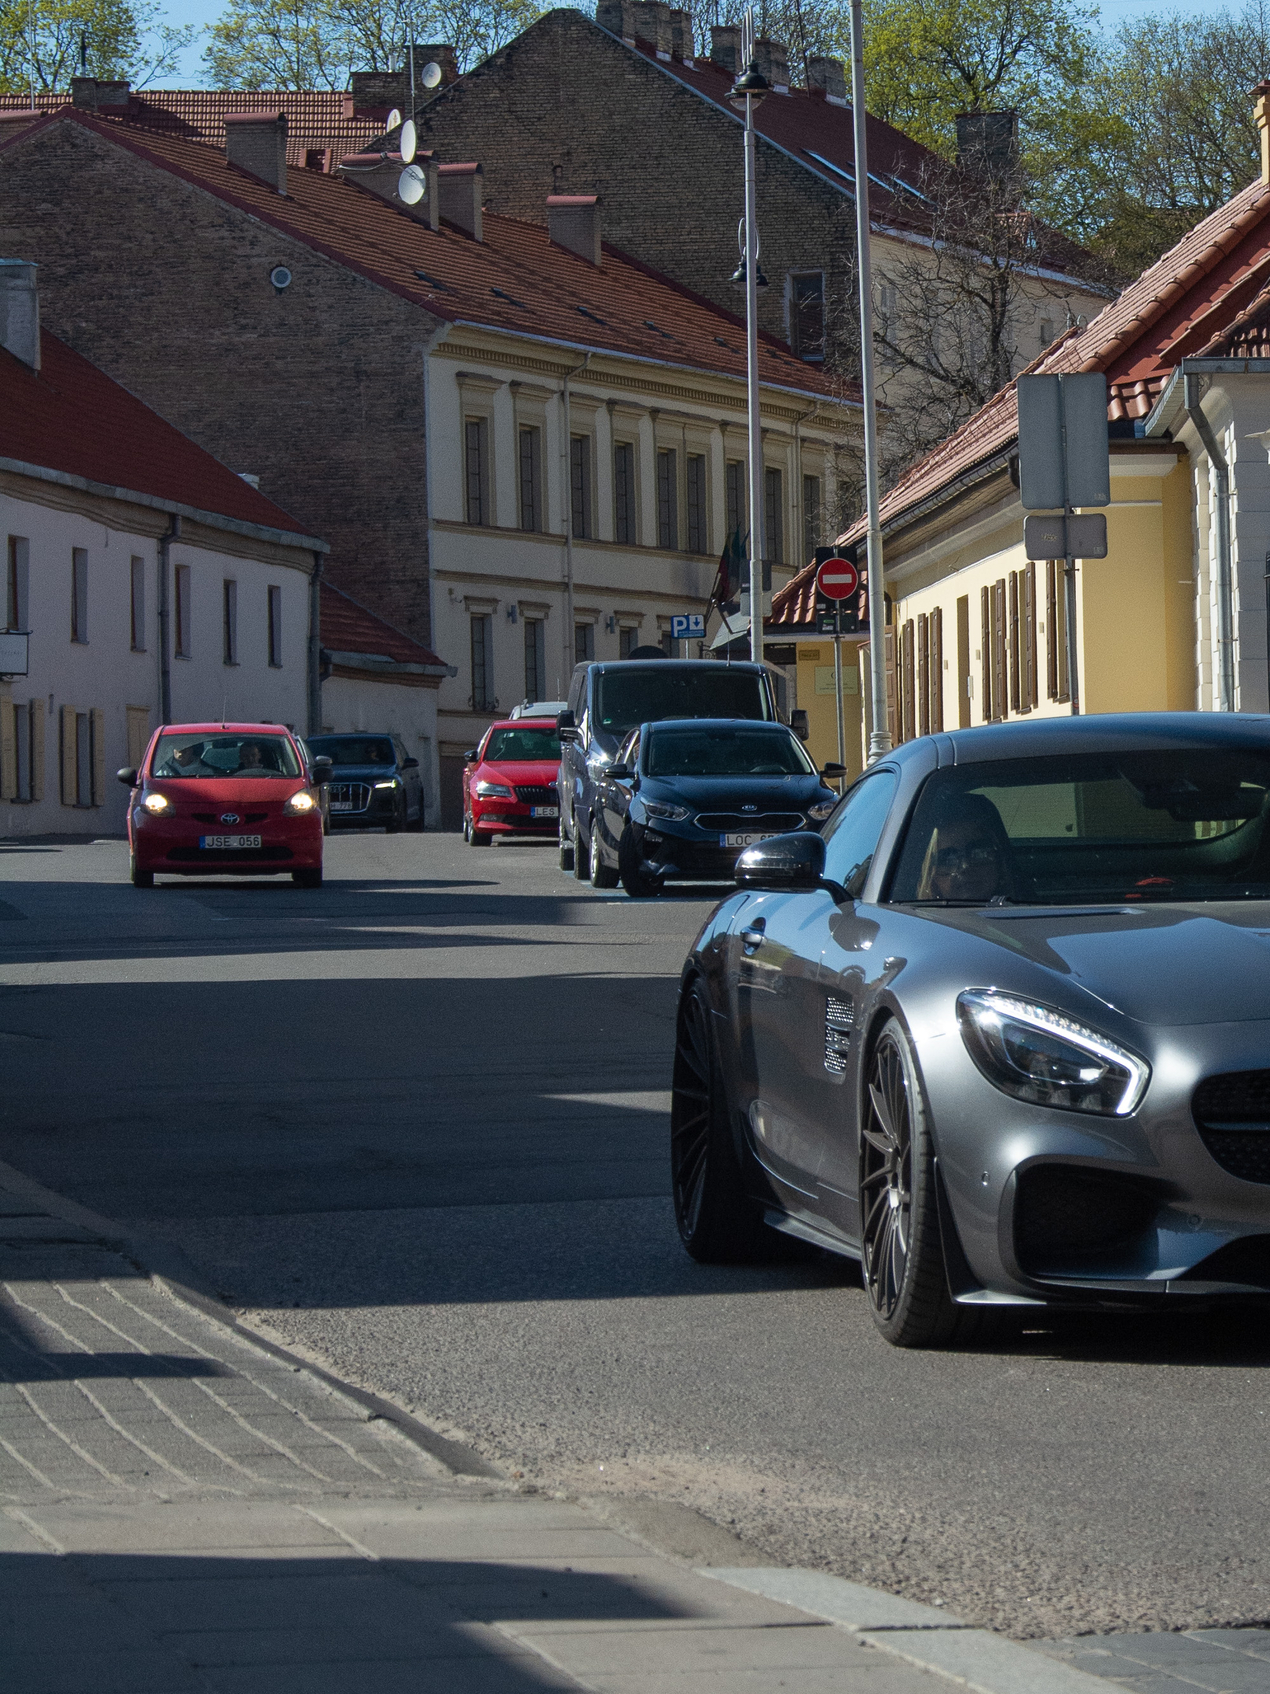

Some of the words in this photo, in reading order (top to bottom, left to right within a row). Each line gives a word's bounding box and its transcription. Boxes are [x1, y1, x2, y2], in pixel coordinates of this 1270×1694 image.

[674, 616, 687, 637] P
[536, 807, 555, 816] LES
[206, 836, 231, 847] JSE
[239, 836, 260, 847] 056
[726, 835, 752, 846] LOC
